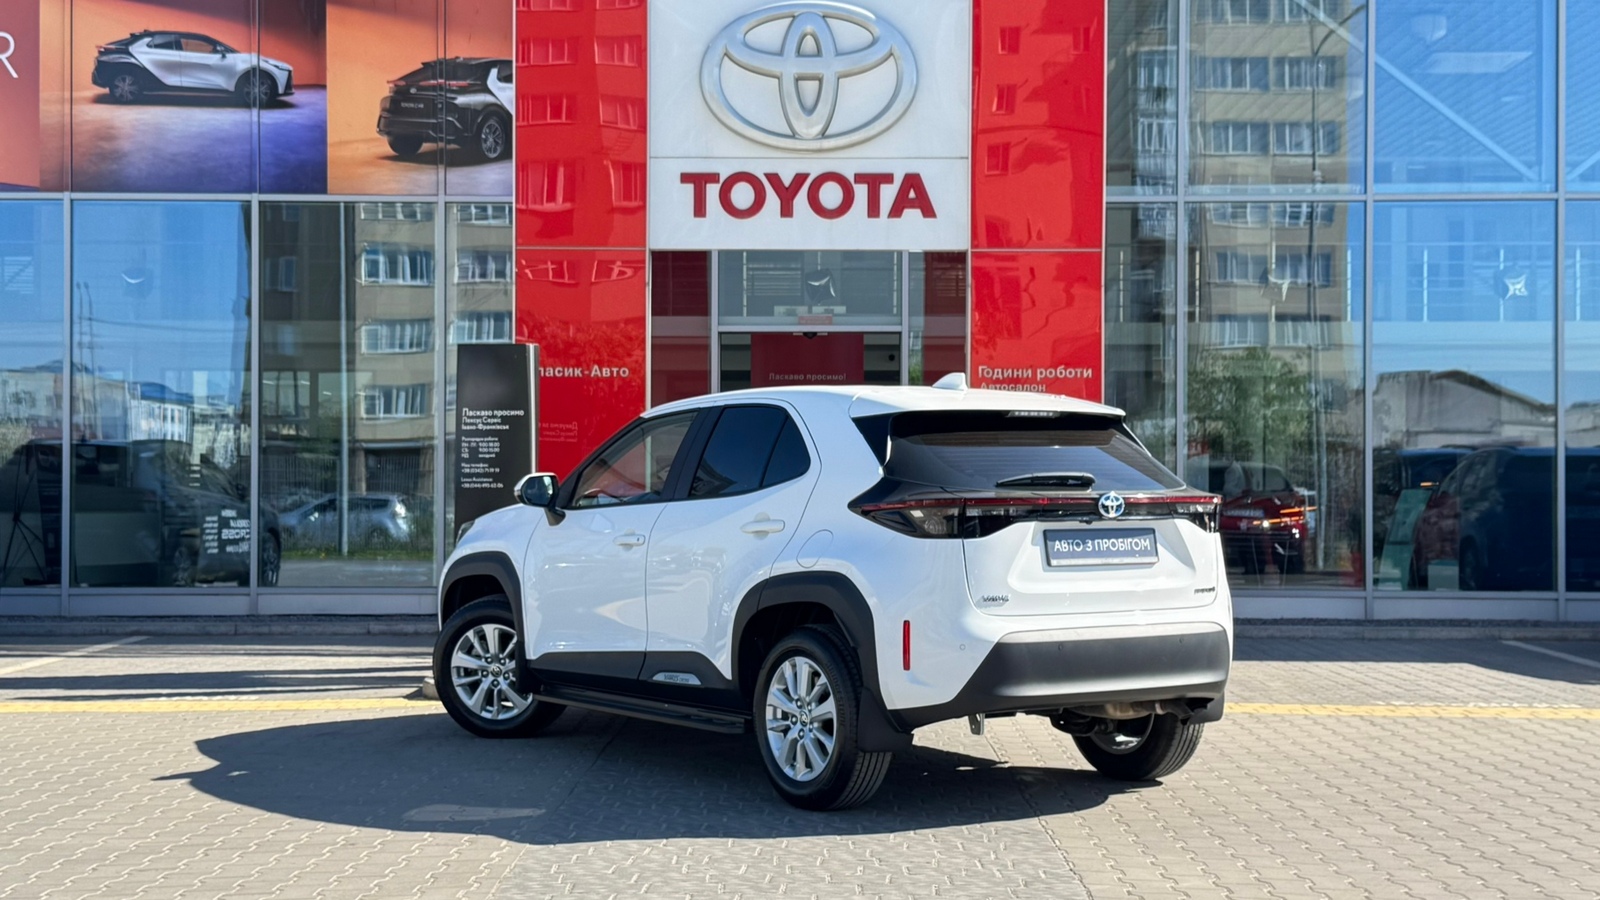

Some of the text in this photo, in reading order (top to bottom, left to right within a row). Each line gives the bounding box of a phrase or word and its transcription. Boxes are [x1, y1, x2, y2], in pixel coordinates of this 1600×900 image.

[681, 172, 937, 220] TOYOTA
[979, 366, 1092, 381] Години роботи
[981, 383, 1046, 392] Автосалон
[1054, 539, 1151, 552] АВТО З ПРОБІГОМ
